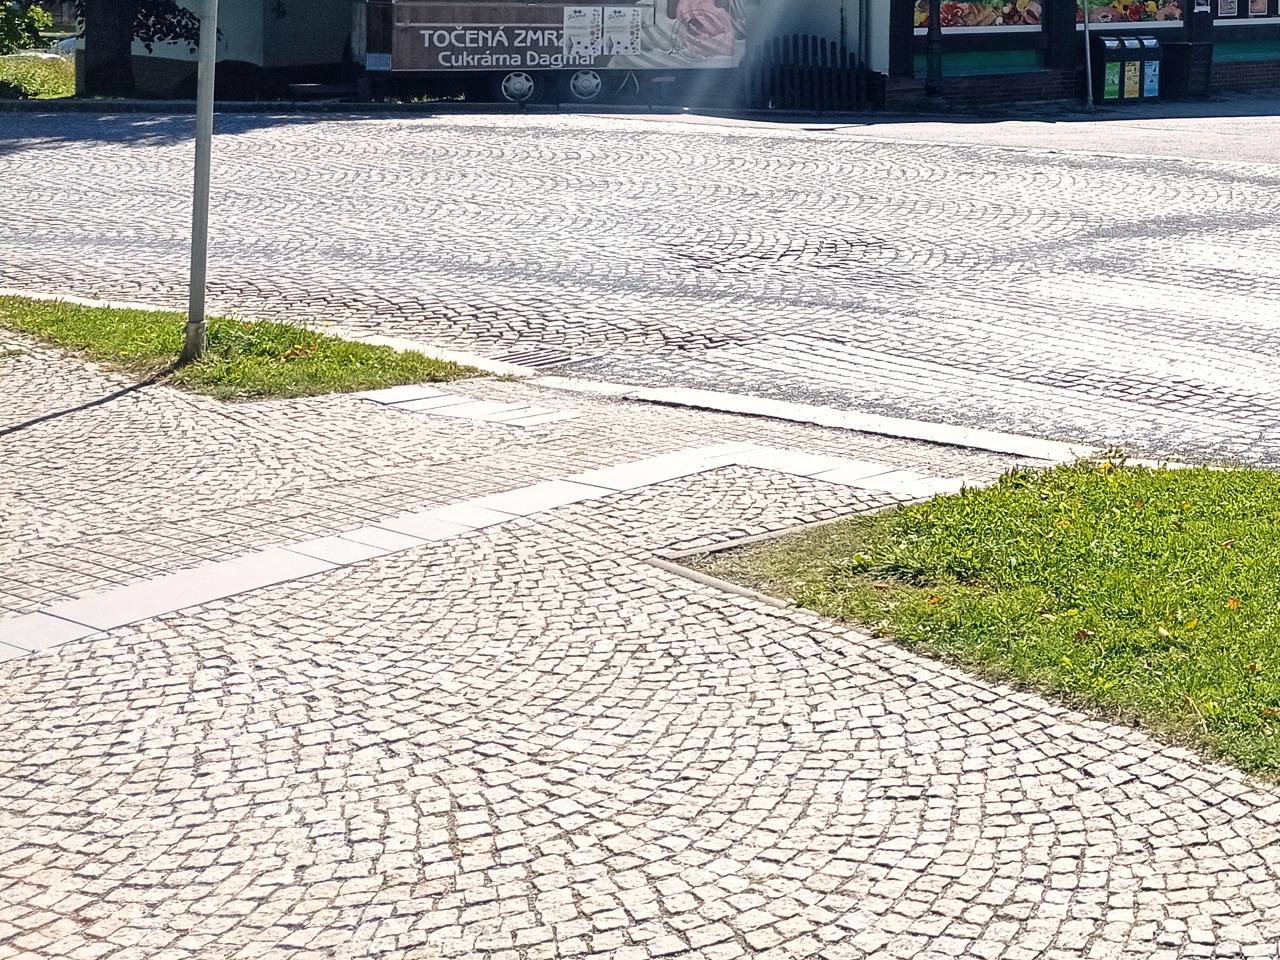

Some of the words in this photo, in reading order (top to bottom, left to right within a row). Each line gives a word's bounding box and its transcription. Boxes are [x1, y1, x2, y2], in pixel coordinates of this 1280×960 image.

[420, 25, 509, 48] TOČENÁ
[438, 50, 521, 67] Cukrárna
[526, 51, 596, 69] Dagmar
